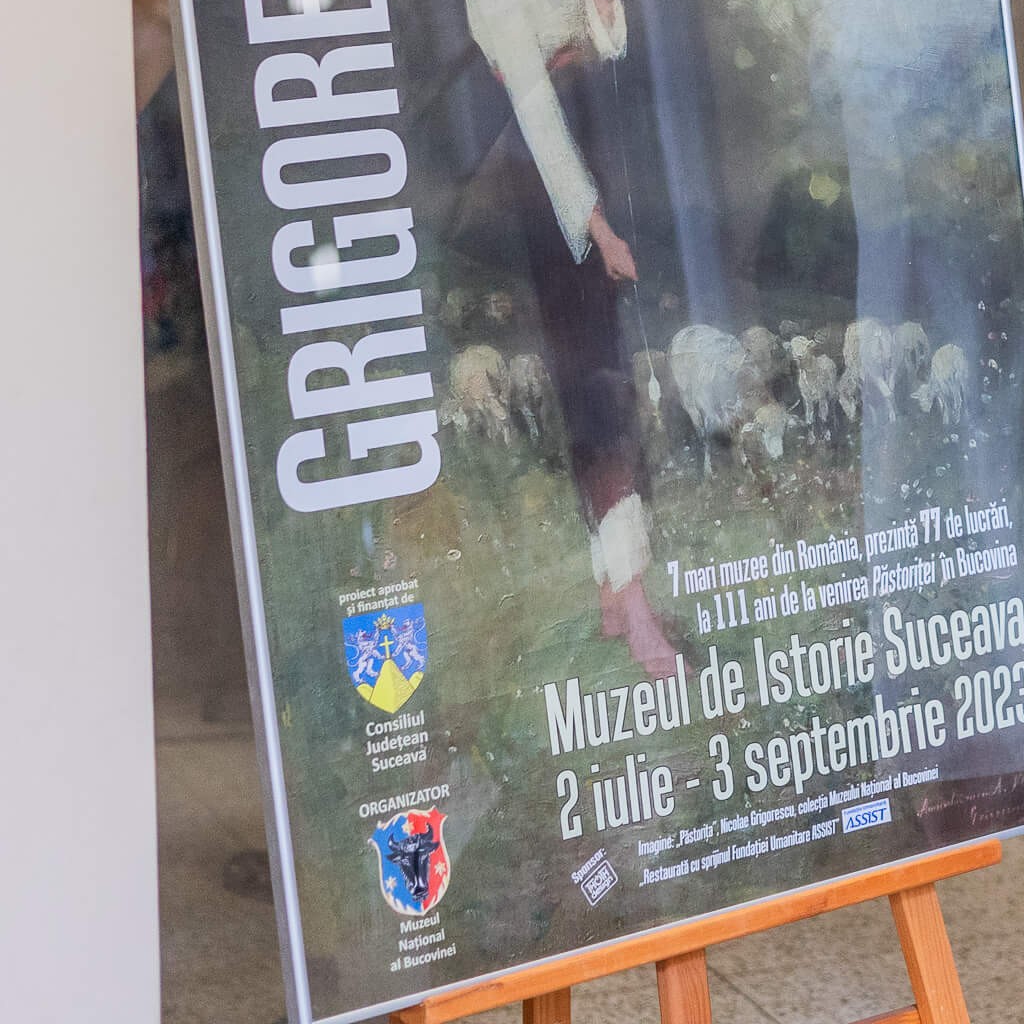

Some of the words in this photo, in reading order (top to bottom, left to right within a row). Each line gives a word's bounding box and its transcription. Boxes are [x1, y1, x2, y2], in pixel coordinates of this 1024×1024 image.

[667, 560, 680, 597] 7
[684, 557, 717, 595] mari
[719, 554, 769, 587] muzee
[771, 543, 796, 576] din
[796, 533, 863, 572] România,
[865, 519, 919, 563] prezintă
[919, 506, 942, 544] 77
[944, 507, 964, 540] de
[963, 497, 1014, 536] lucrări,
[338, 586, 376, 606] proiect
[377, 578, 419, 598] aprobat
[356, 596, 400, 614] finanțat
[400, 591, 415, 604] de
[696, 602, 712, 635] la
[713, 588, 750, 631] 111
[753, 587, 778, 622] ani
[780, 584, 800, 617] de
[800, 580, 817, 612] la
[818, 572, 870, 609] venirea
[938, 551, 956, 581] în
[955, 539, 1018, 578] Bucovina
[543, 652, 691, 757] Muzeul
[699, 644, 747, 721] de
[752, 618, 876, 708] Istorie
[366, 710, 426, 738] Consiliul
[366, 730, 429, 756] Județean
[371, 749, 428, 772] Suceava
[555, 769, 584, 841] 2
[590, 752, 677, 833] iulie
[685, 777, 701, 790] -
[707, 732, 735, 801] 3
[743, 686, 947, 796] septembrie
[358, 783, 451, 818] ORGANIZATOR
[720, 813, 751, 835] Nicolae
[798, 793, 829, 815] colecția
[829, 783, 861, 807] Muzeului
[893, 773, 902, 789] al
[902, 764, 940, 787] Bucovinei
[690, 858, 701, 872] cu
[769, 827, 812, 852] Umanitare
[571, 847, 608, 885] Sponsor:
[399, 912, 440, 935] Muzeul
[398, 928, 446, 953] Național
[390, 959, 401, 973] al
[402, 943, 457, 970] Bucovinei
